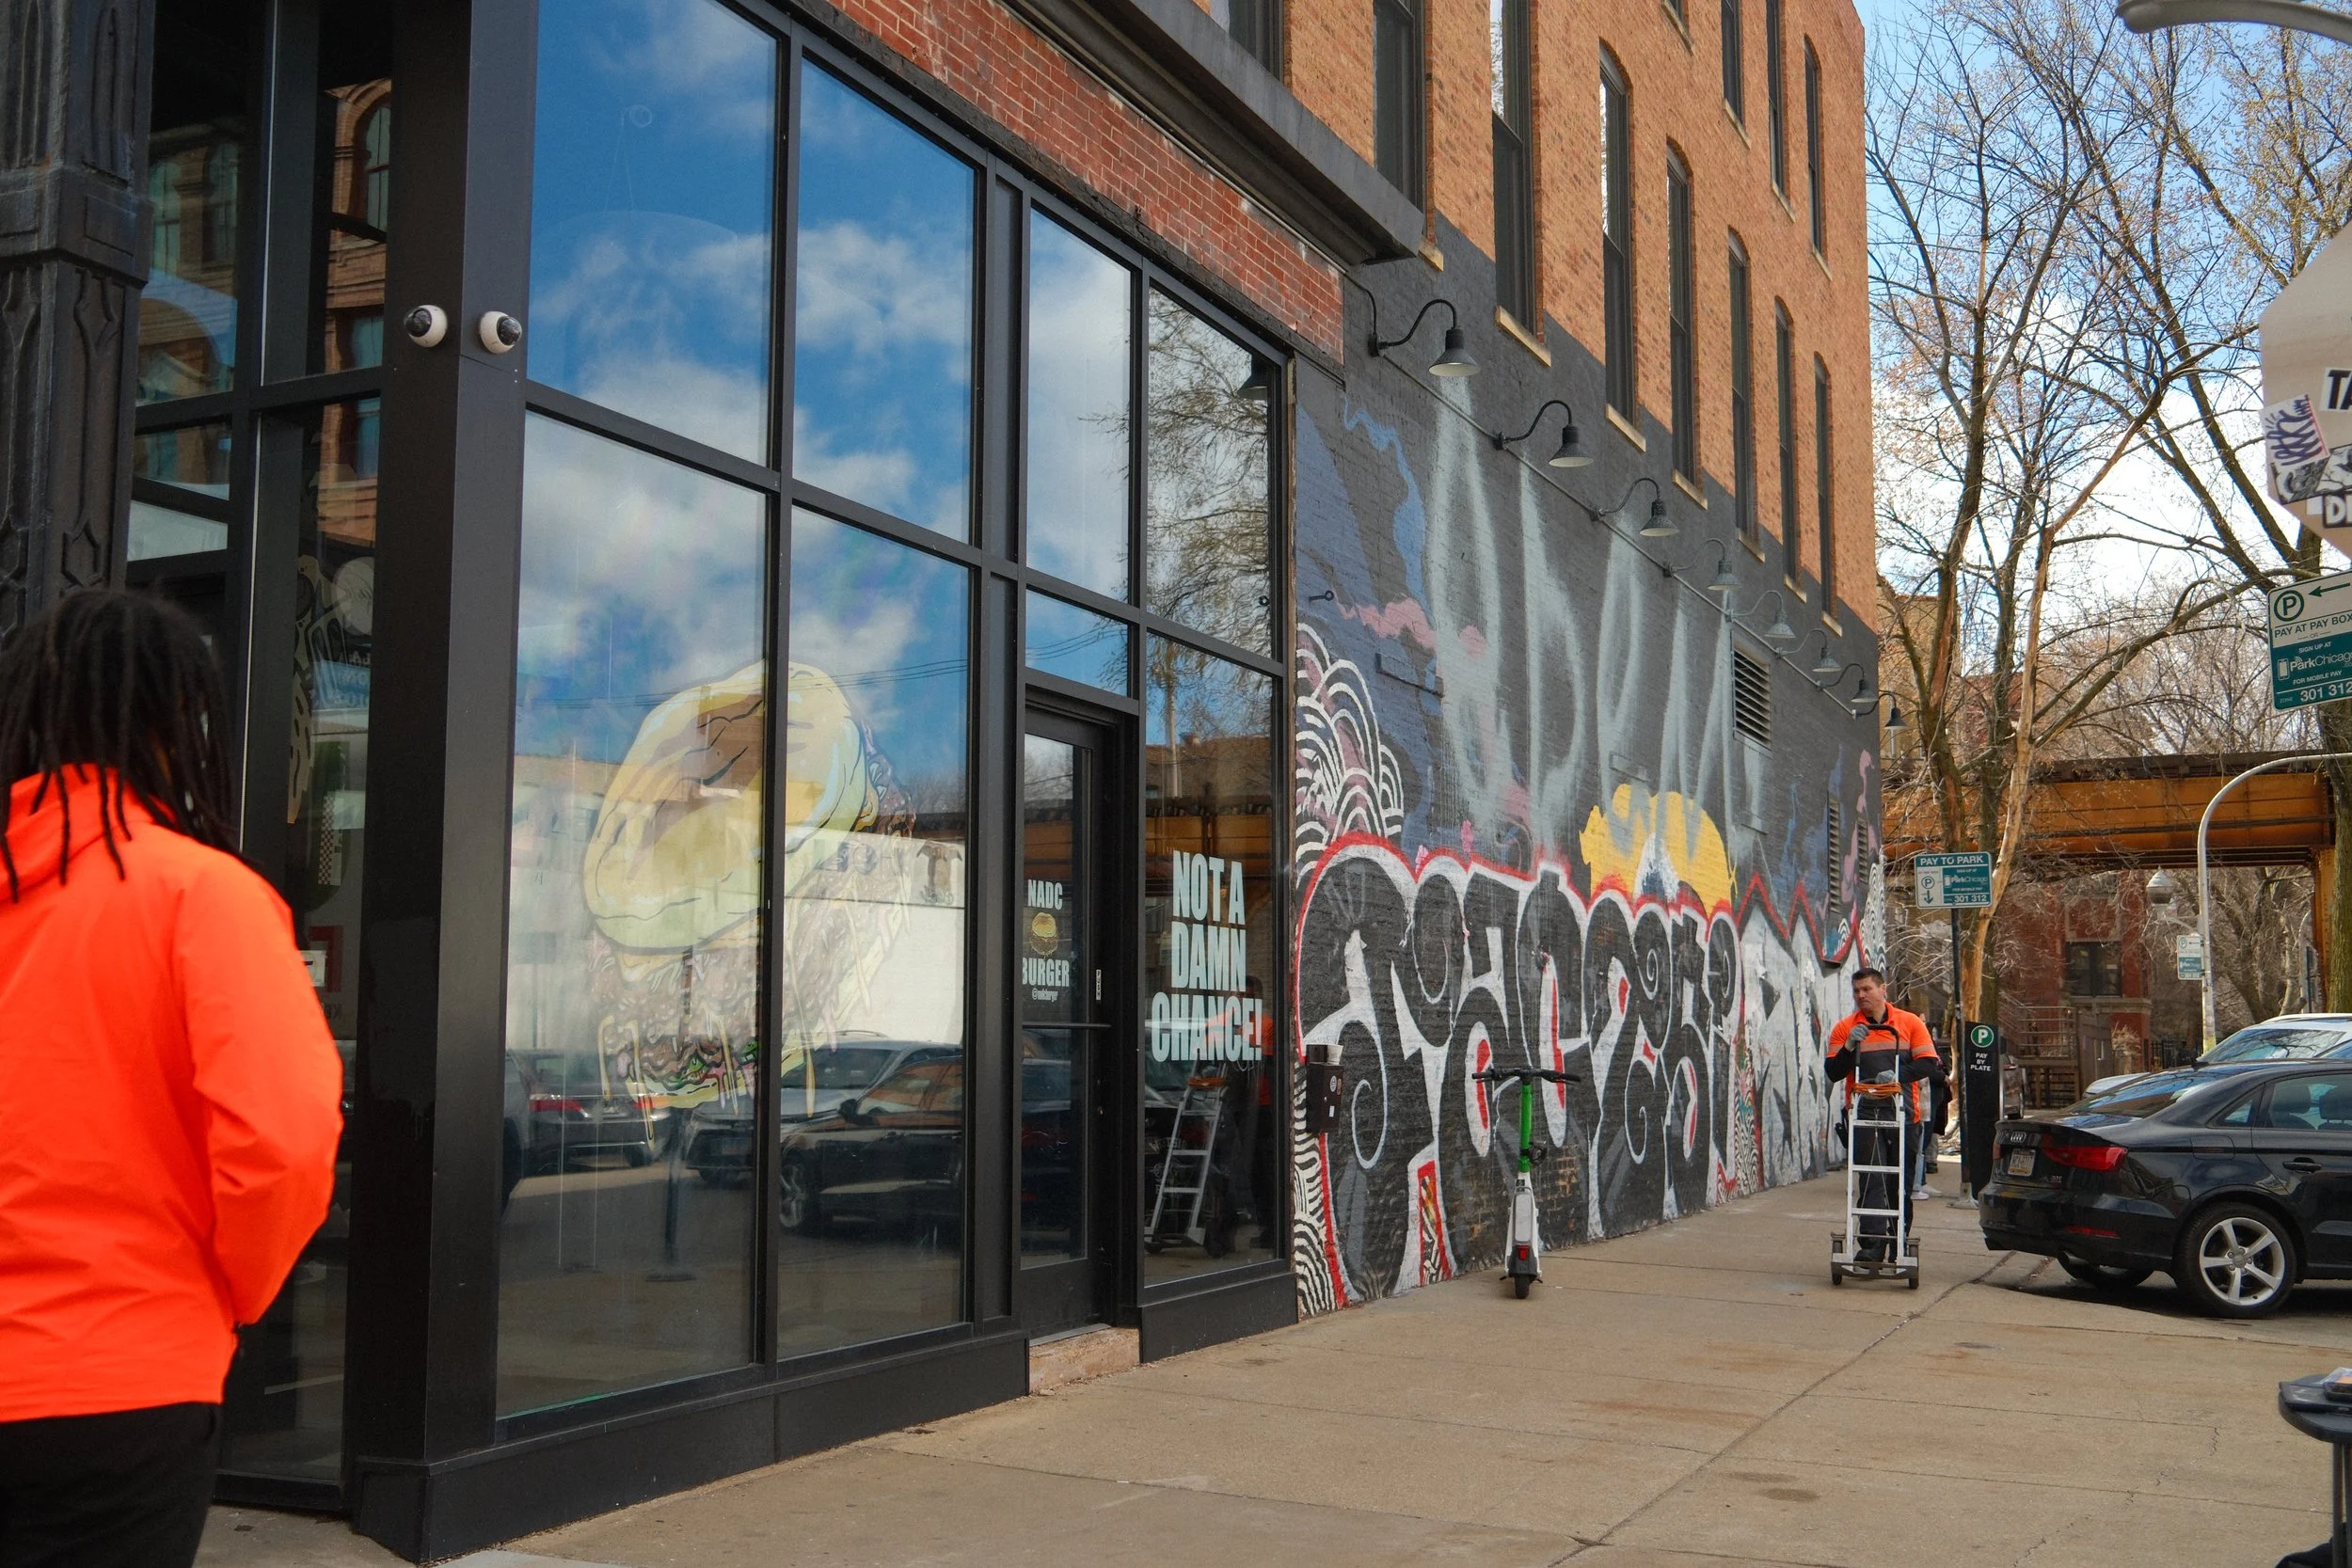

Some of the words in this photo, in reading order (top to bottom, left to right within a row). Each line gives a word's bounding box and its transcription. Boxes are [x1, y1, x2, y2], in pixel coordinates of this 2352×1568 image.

[2274, 626, 2293, 639] PAY
[2295, 623, 2307, 634] AT
[2310, 618, 2329, 631] PAY
[2298, 645, 2313, 654] SIGN
[2290, 650, 2352, 672] ParkChicag
[2293, 677, 2306, 686] FOR
[2306, 673, 2329, 683] MOBILE
[2330, 670, 2343, 678] PAY
[2300, 688, 2324, 703] 301
[2328, 681, 2352, 697] 312
[1920, 857, 1938, 865] PAY
[1941, 856, 1954, 864] TO
[1957, 855, 1983, 863] PARK
[1027, 879, 1063, 911] NADC
[1172, 849, 1224, 922] NOT
[1228, 861, 1246, 926] A
[1171, 921, 1247, 992] DAMN
[1022, 957, 1070, 988] BURGER
[1152, 991, 1263, 1063] CHANCE!
